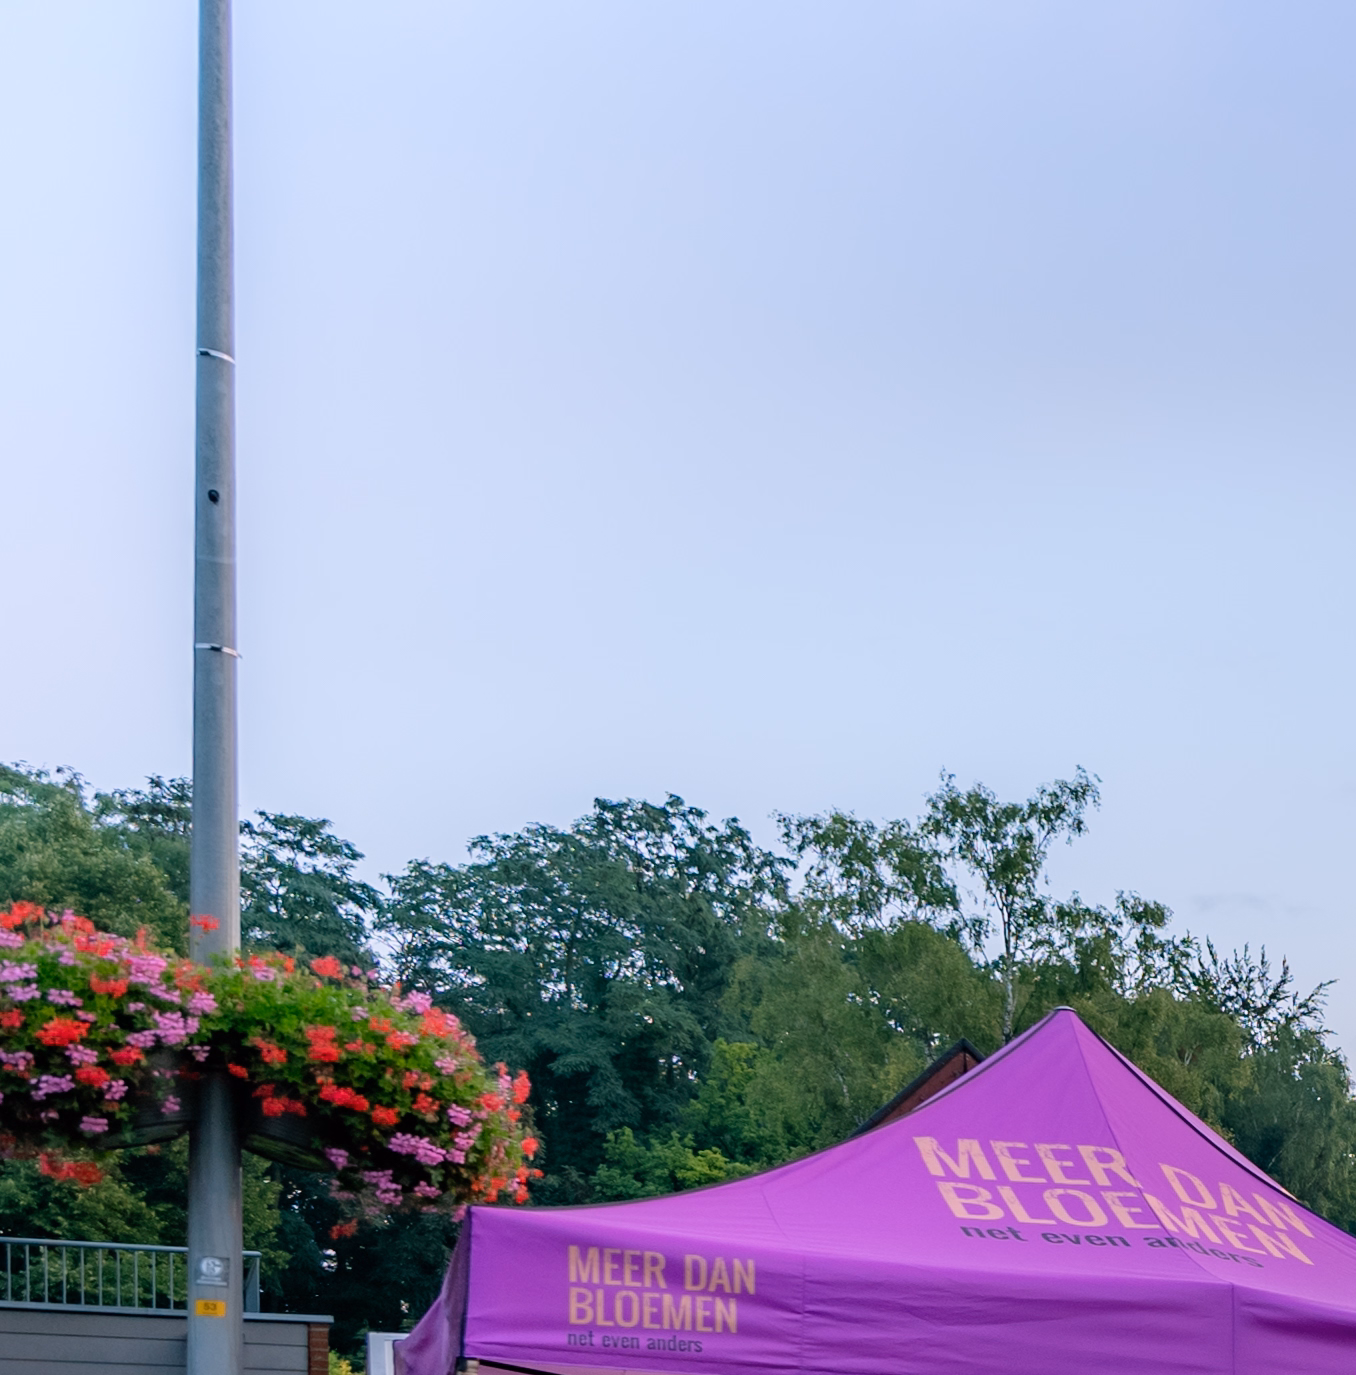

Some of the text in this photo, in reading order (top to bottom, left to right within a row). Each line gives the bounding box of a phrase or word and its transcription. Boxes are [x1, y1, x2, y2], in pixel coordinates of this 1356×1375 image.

[911, 1135, 1315, 1239] MEER DAN
[935, 1180, 1315, 1266] BLOEMEN
[959, 1225, 1265, 1269] net even anders
[567, 1245, 757, 1296] MEER DAN
[568, 1286, 739, 1334] BLOEMEN
[567, 1330, 703, 1353] net even anders
